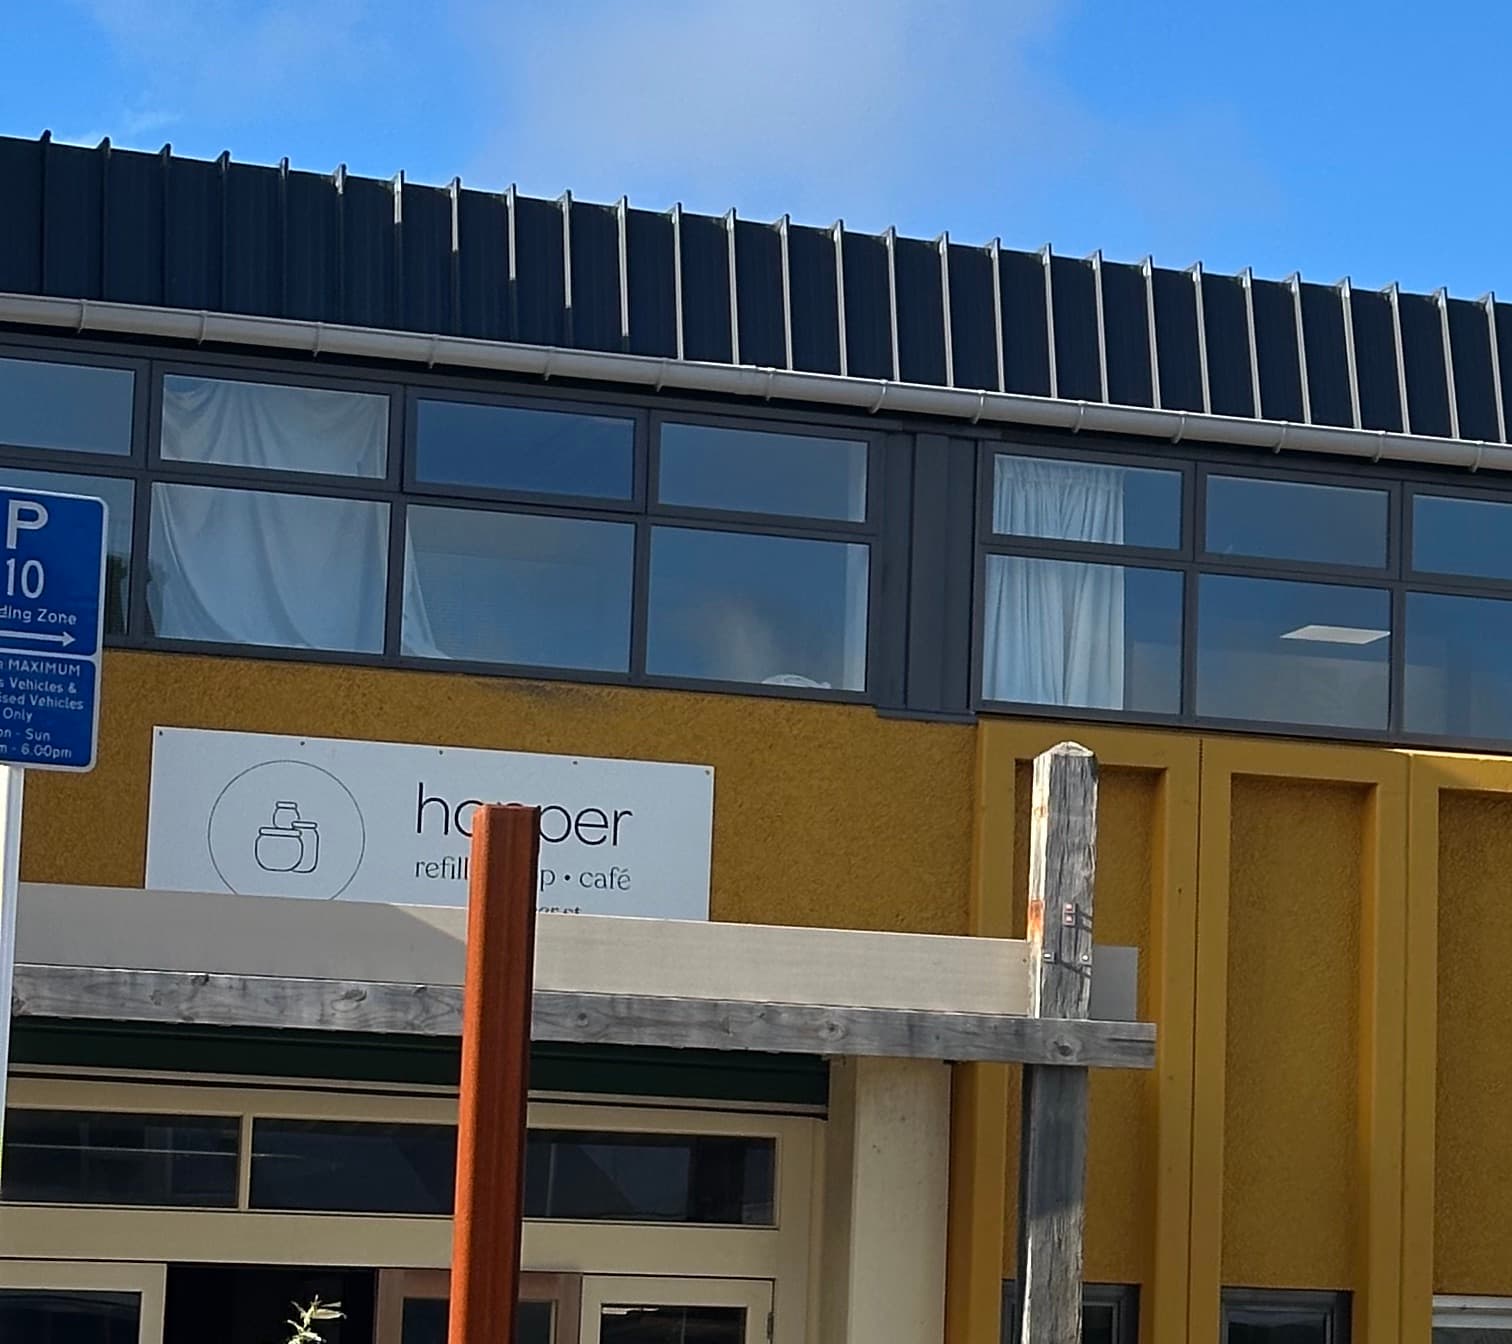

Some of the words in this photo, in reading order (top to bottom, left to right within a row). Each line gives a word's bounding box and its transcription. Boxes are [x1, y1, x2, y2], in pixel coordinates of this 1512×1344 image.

[6, 499, 48, 549] P
[6, 558, 44, 599] 10
[37, 608, 77, 625] Zone
[8, 659, 80, 677] MAXIMUM
[9, 676, 64, 693] Vehicles
[68, 682, 77, 694] &
[30, 694, 84, 710] Vehicles
[3, 707, 33, 724] Only
[25, 728, 50, 742] Sun
[21, 743, 72, 759] 6.00pm
[416, 782, 633, 846] hoper
[579, 866, 631, 891] café
